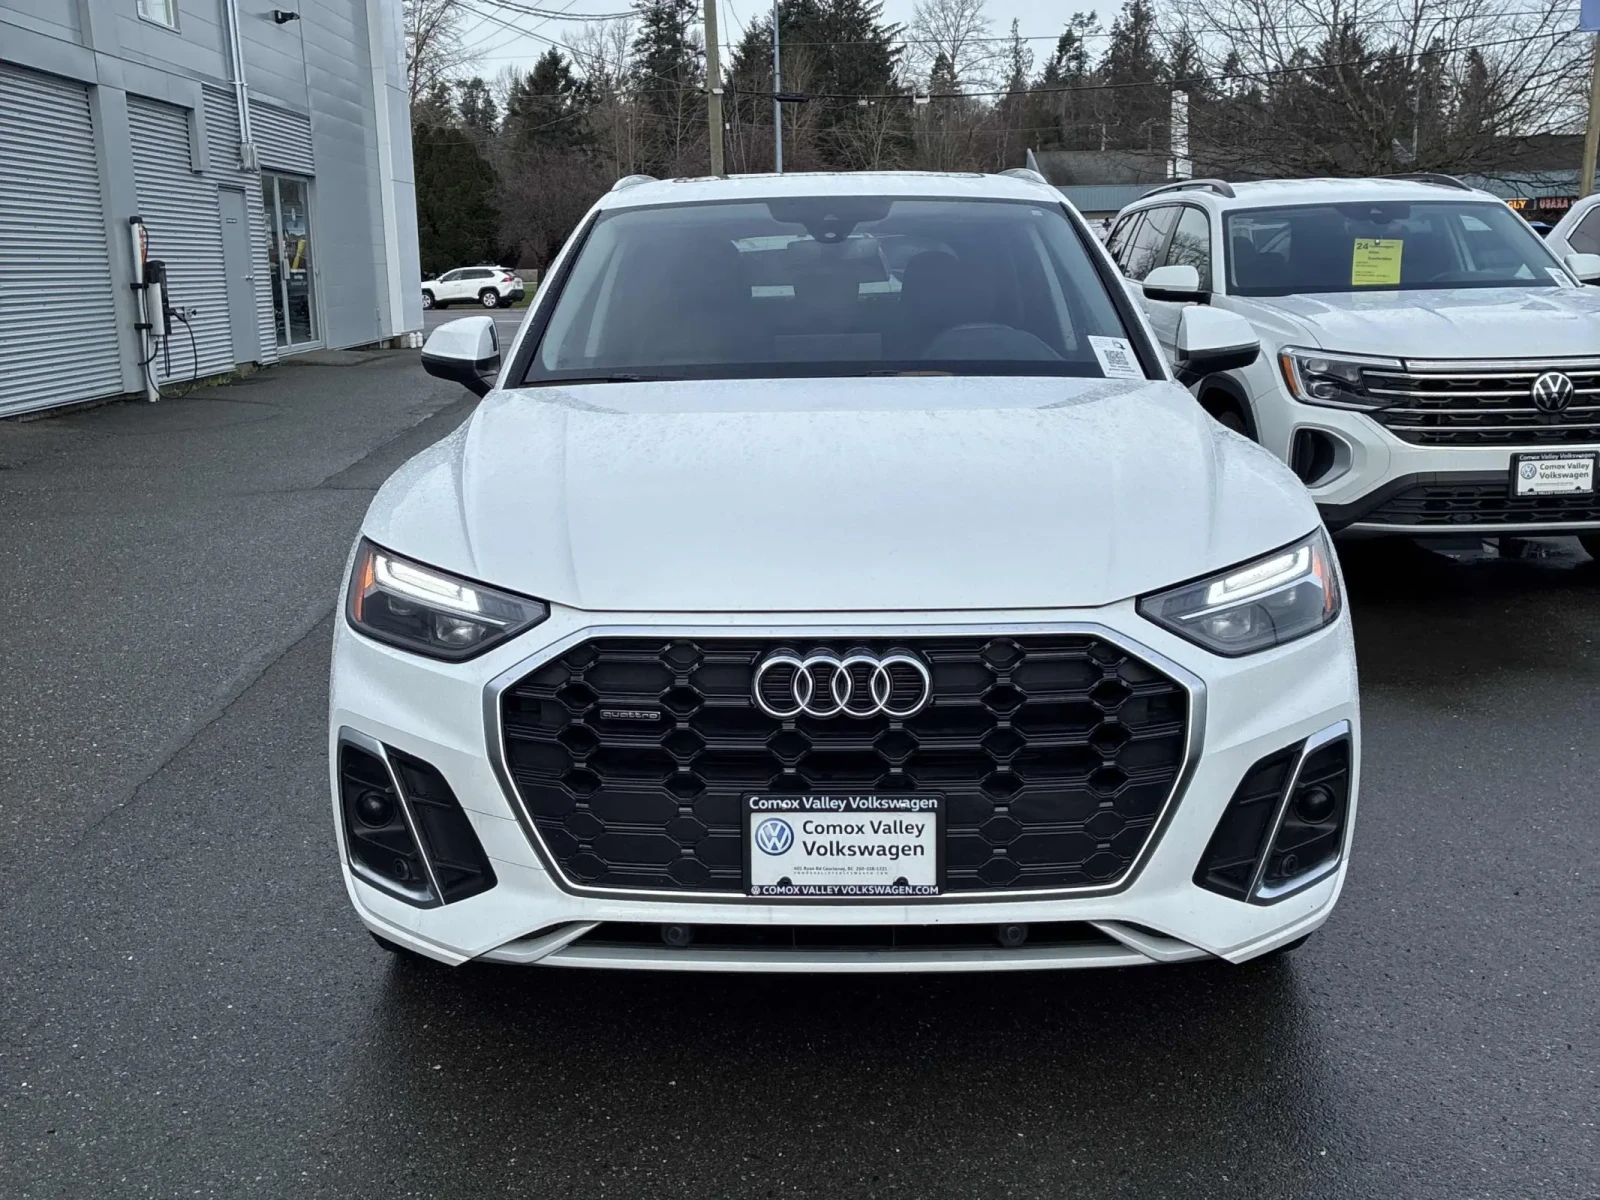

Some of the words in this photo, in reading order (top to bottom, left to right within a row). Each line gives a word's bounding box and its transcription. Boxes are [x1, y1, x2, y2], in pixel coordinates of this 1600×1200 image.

[1356, 242, 1369, 250] 24
[1560, 452, 1596, 460] Volkswagen
[1567, 462, 1590, 470] Valley
[1540, 471, 1589, 480] Volkswagen
[749, 796, 800, 810] Comox
[802, 796, 847, 812] Valley
[849, 796, 938, 812] Volkswagen
[802, 820, 865, 835] Comox
[869, 820, 925, 838] Valley
[802, 840, 925, 860] Volkswagen
[763, 885, 800, 895] COMOX
[801, 885, 839, 895] VALLEY
[840, 885, 939, 895] VOLKSWAGEN.COM
